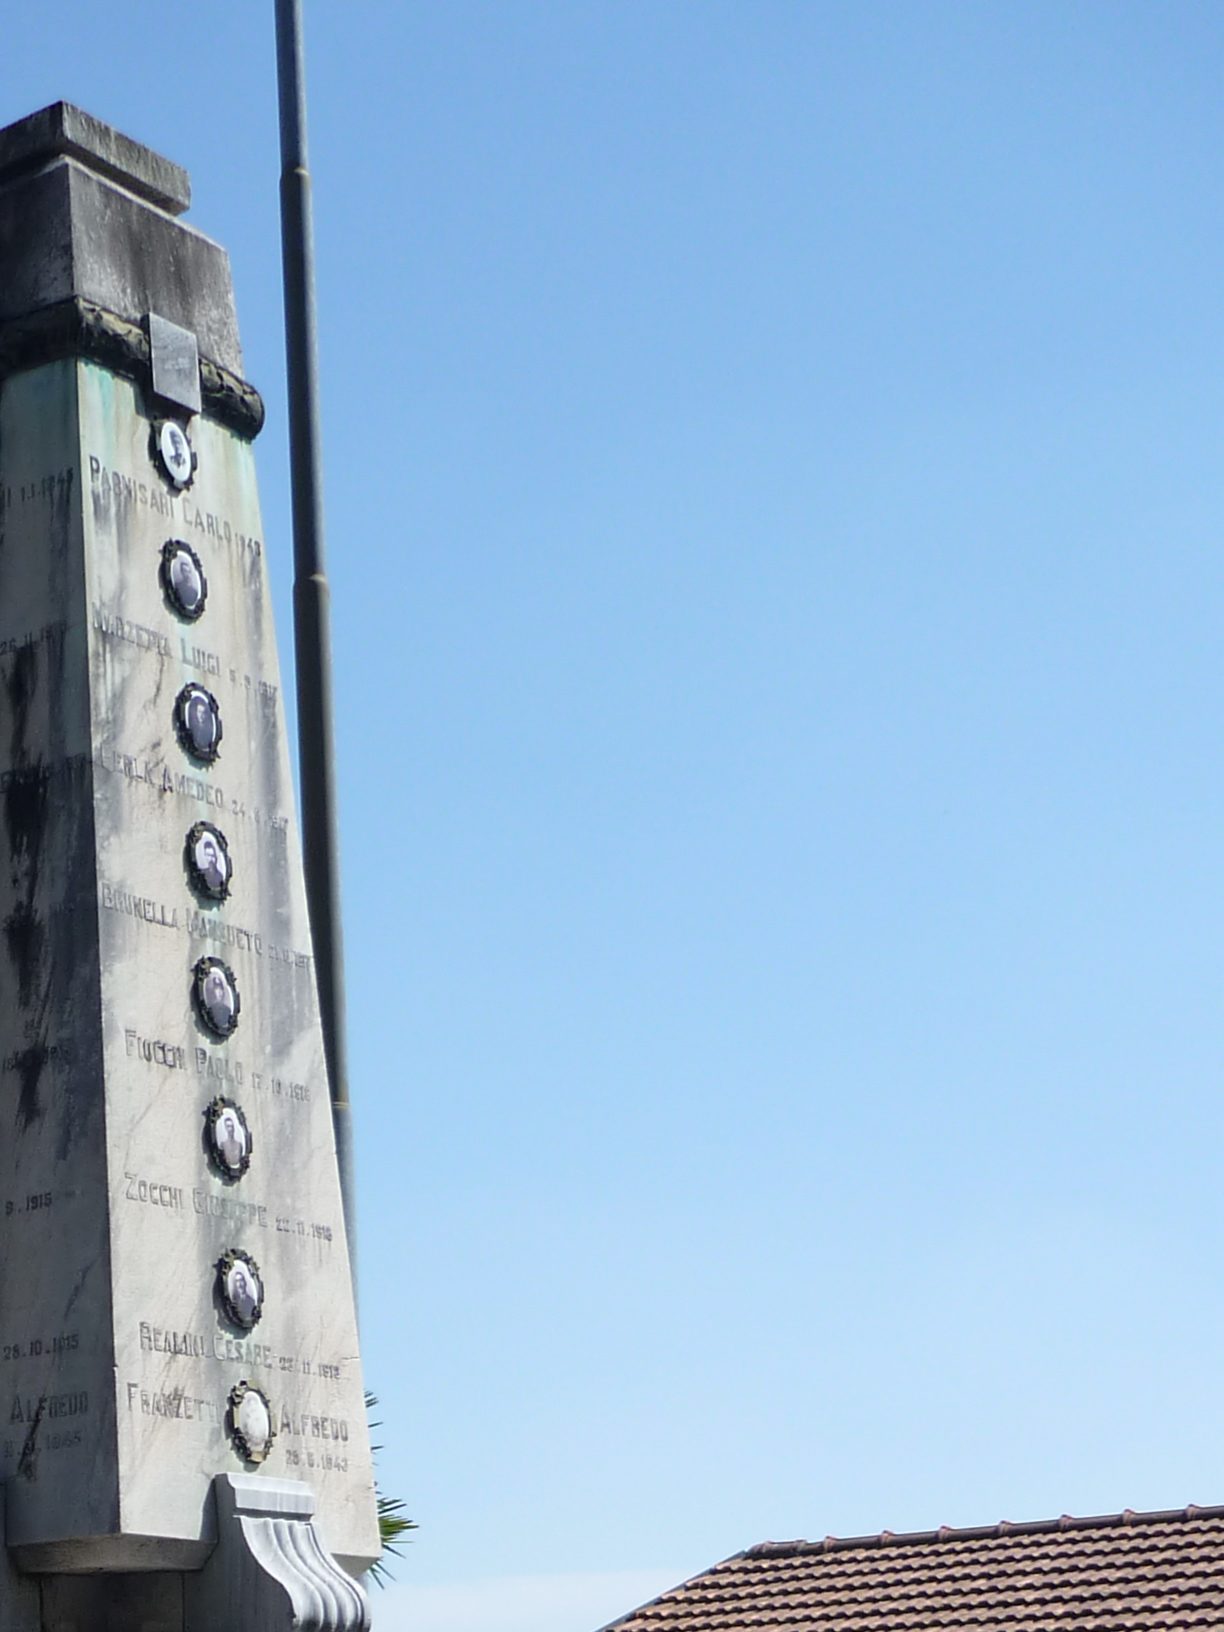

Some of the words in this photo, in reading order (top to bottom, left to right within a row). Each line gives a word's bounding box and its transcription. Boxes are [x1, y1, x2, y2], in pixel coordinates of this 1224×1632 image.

[182, 500, 232, 543] CARLO
[179, 637, 222, 679] LUIGI
[194, 1046, 244, 1086] PAOLO
[124, 1172, 185, 1211] ZOCCHI
[213, 1335, 274, 1372] CESARE
[279, 1405, 350, 1443] ALFREDO
